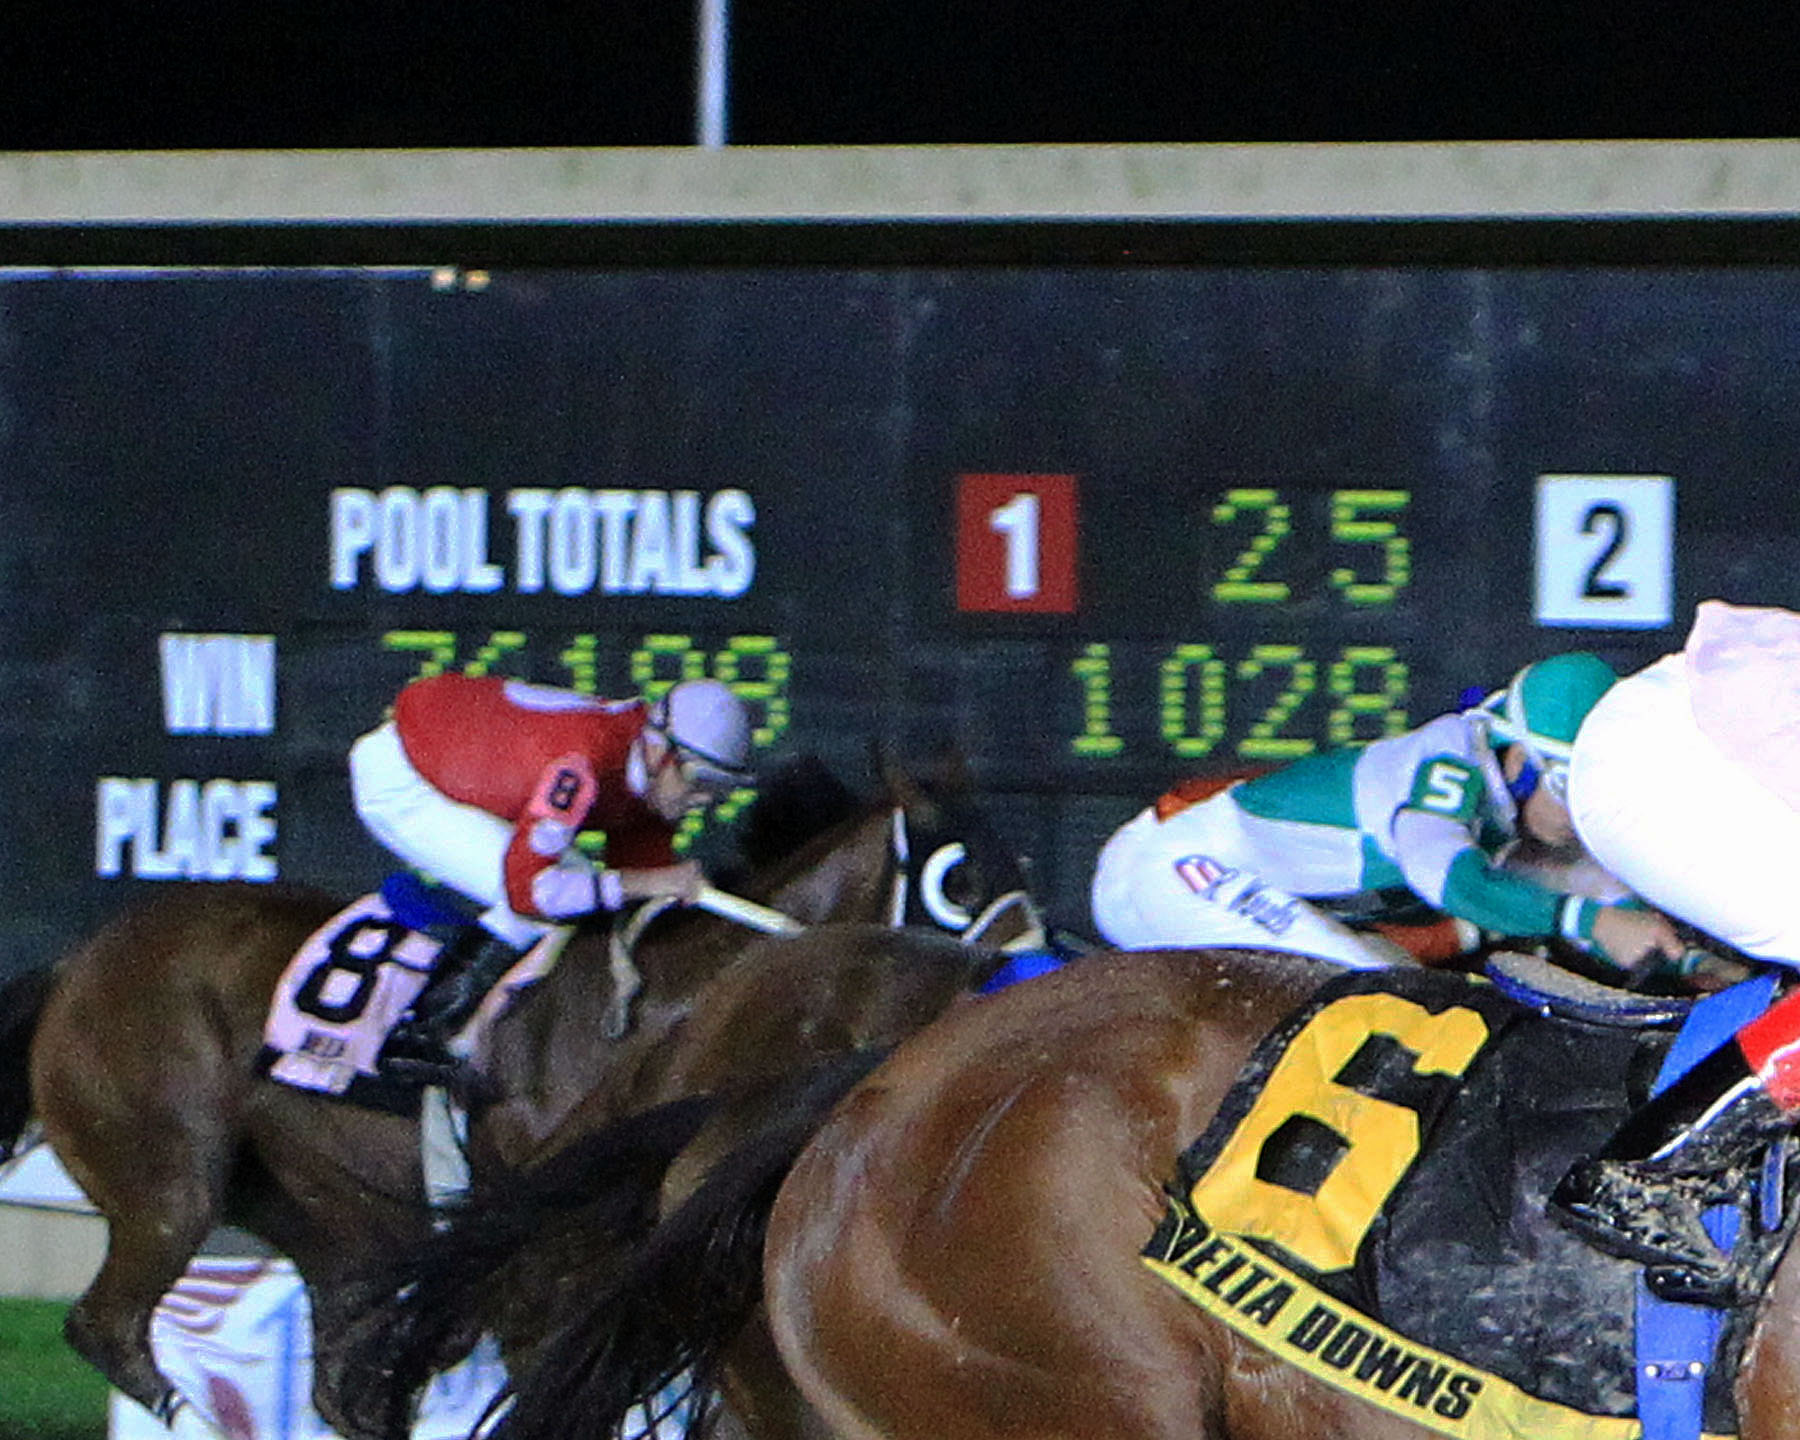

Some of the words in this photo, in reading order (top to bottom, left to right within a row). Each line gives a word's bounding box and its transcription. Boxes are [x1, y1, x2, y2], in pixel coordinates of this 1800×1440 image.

[331, 486, 505, 594] POOL
[507, 486, 757, 597] TOTALS
[989, 492, 1041, 599] 1
[1212, 488, 1411, 602] 25
[1578, 498, 1630, 599] 2
[159, 632, 277, 736] WIN
[1071, 643, 1410, 759] 1028
[97, 777, 278, 882] PLACE
[549, 768, 580, 811] 8
[296, 916, 406, 1024] 8
[1189, 992, 1490, 1274] 6
[1286, 1301, 1484, 1421] DOWNS
